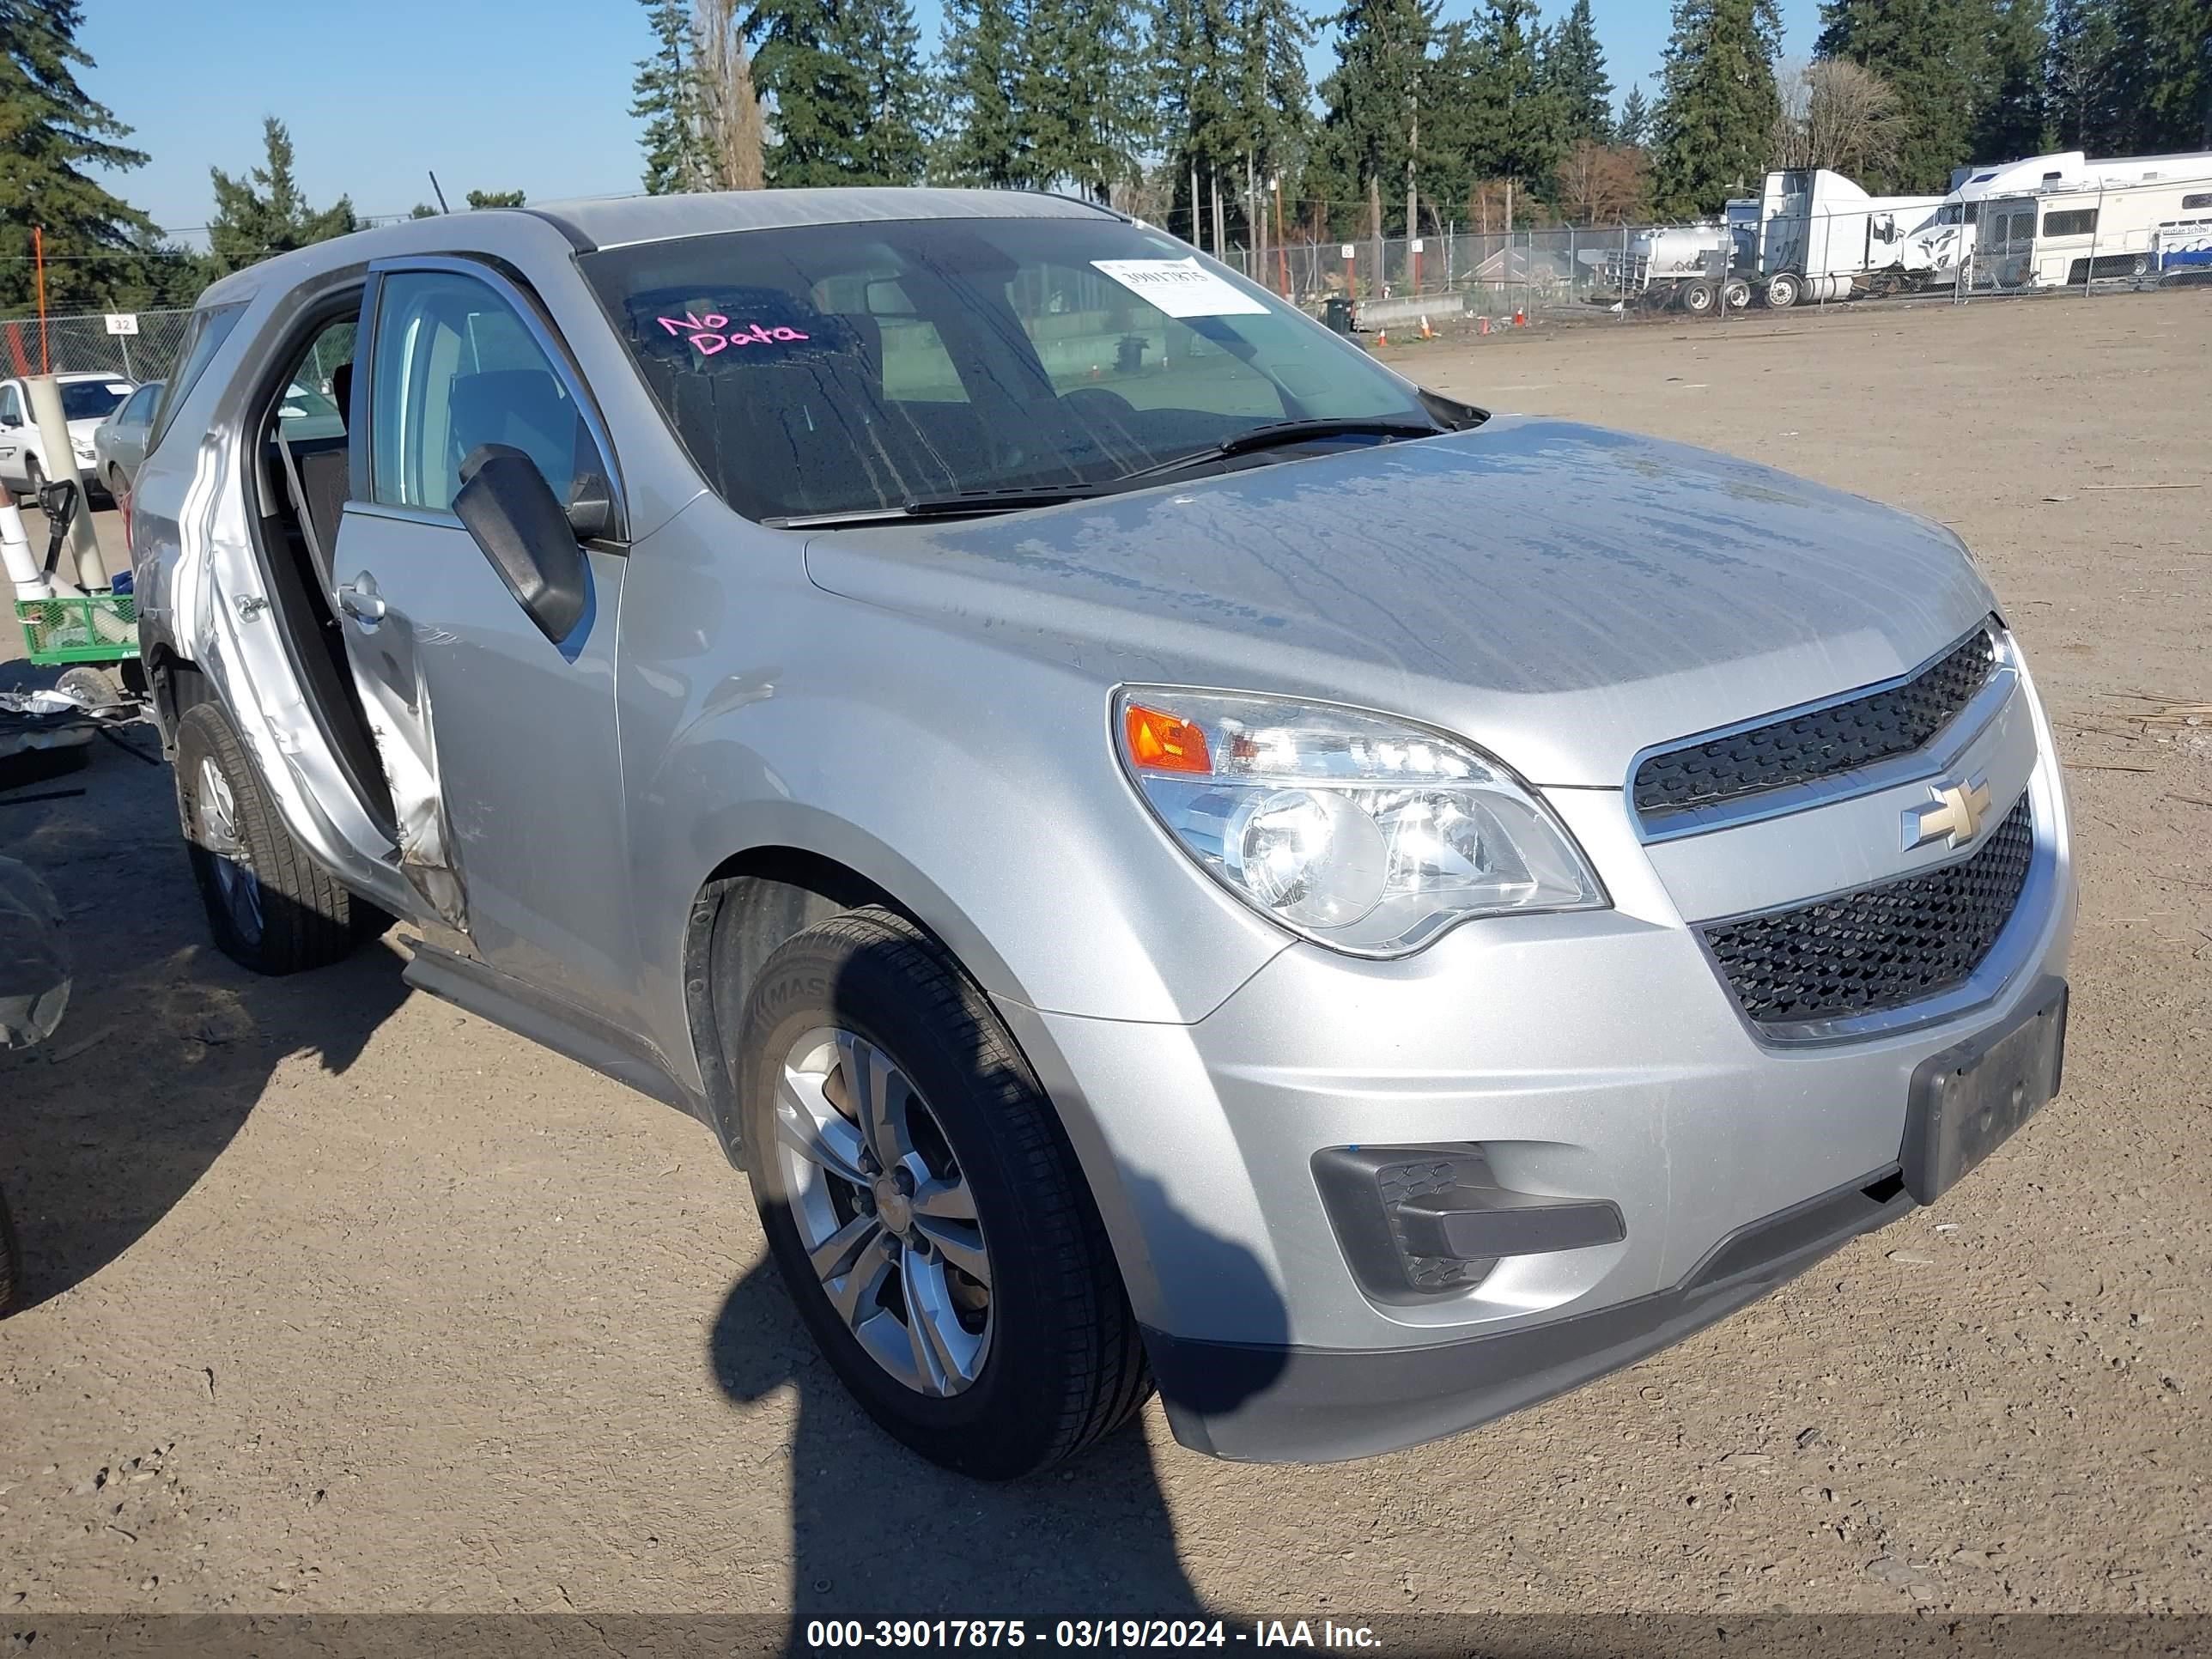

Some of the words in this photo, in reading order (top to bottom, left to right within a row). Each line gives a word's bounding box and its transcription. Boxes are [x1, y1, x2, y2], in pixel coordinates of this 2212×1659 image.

[1121, 271, 1208, 283] 39017875
[114, 319, 131, 331] 32
[656, 310, 730, 336] No
[688, 323, 810, 356] Data
